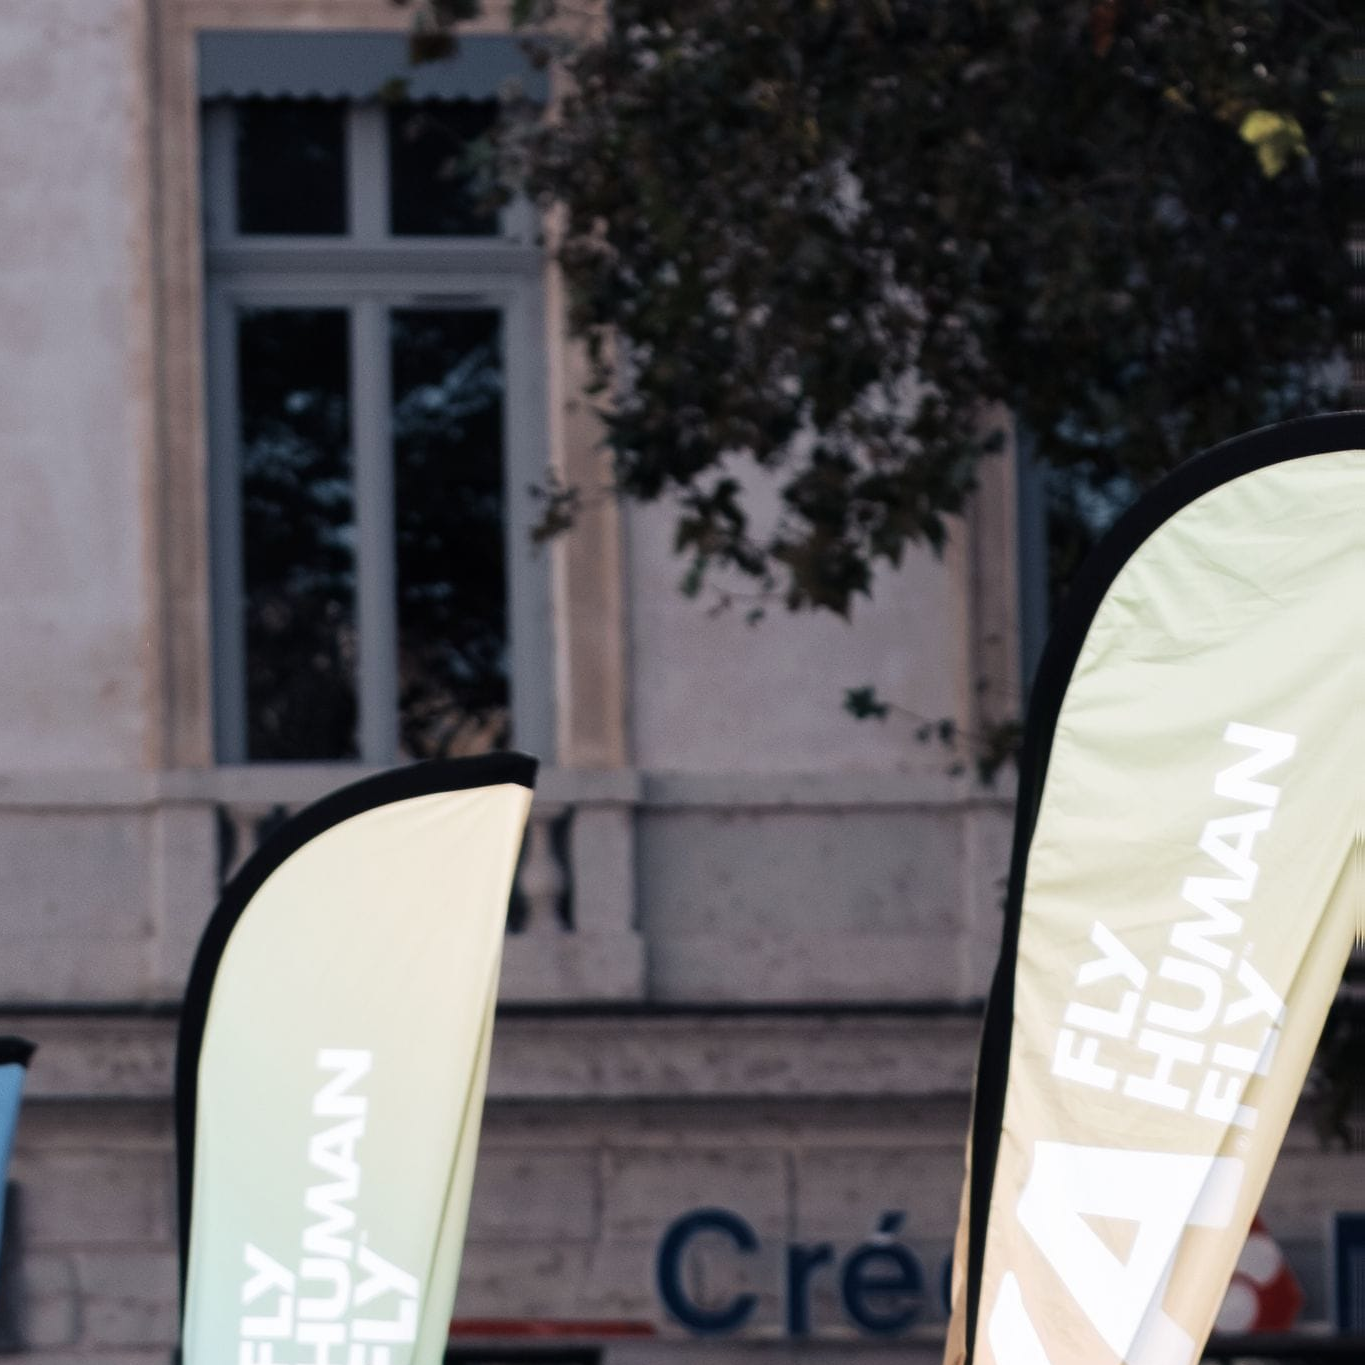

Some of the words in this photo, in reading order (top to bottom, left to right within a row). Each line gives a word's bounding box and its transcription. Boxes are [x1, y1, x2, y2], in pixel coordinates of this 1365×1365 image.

[1123, 721, 1298, 1111] HUMAN
[1051, 920, 1148, 1090] FLY
[1195, 955, 1287, 1130] FLY
[655, 1207, 952, 1338] Cré
